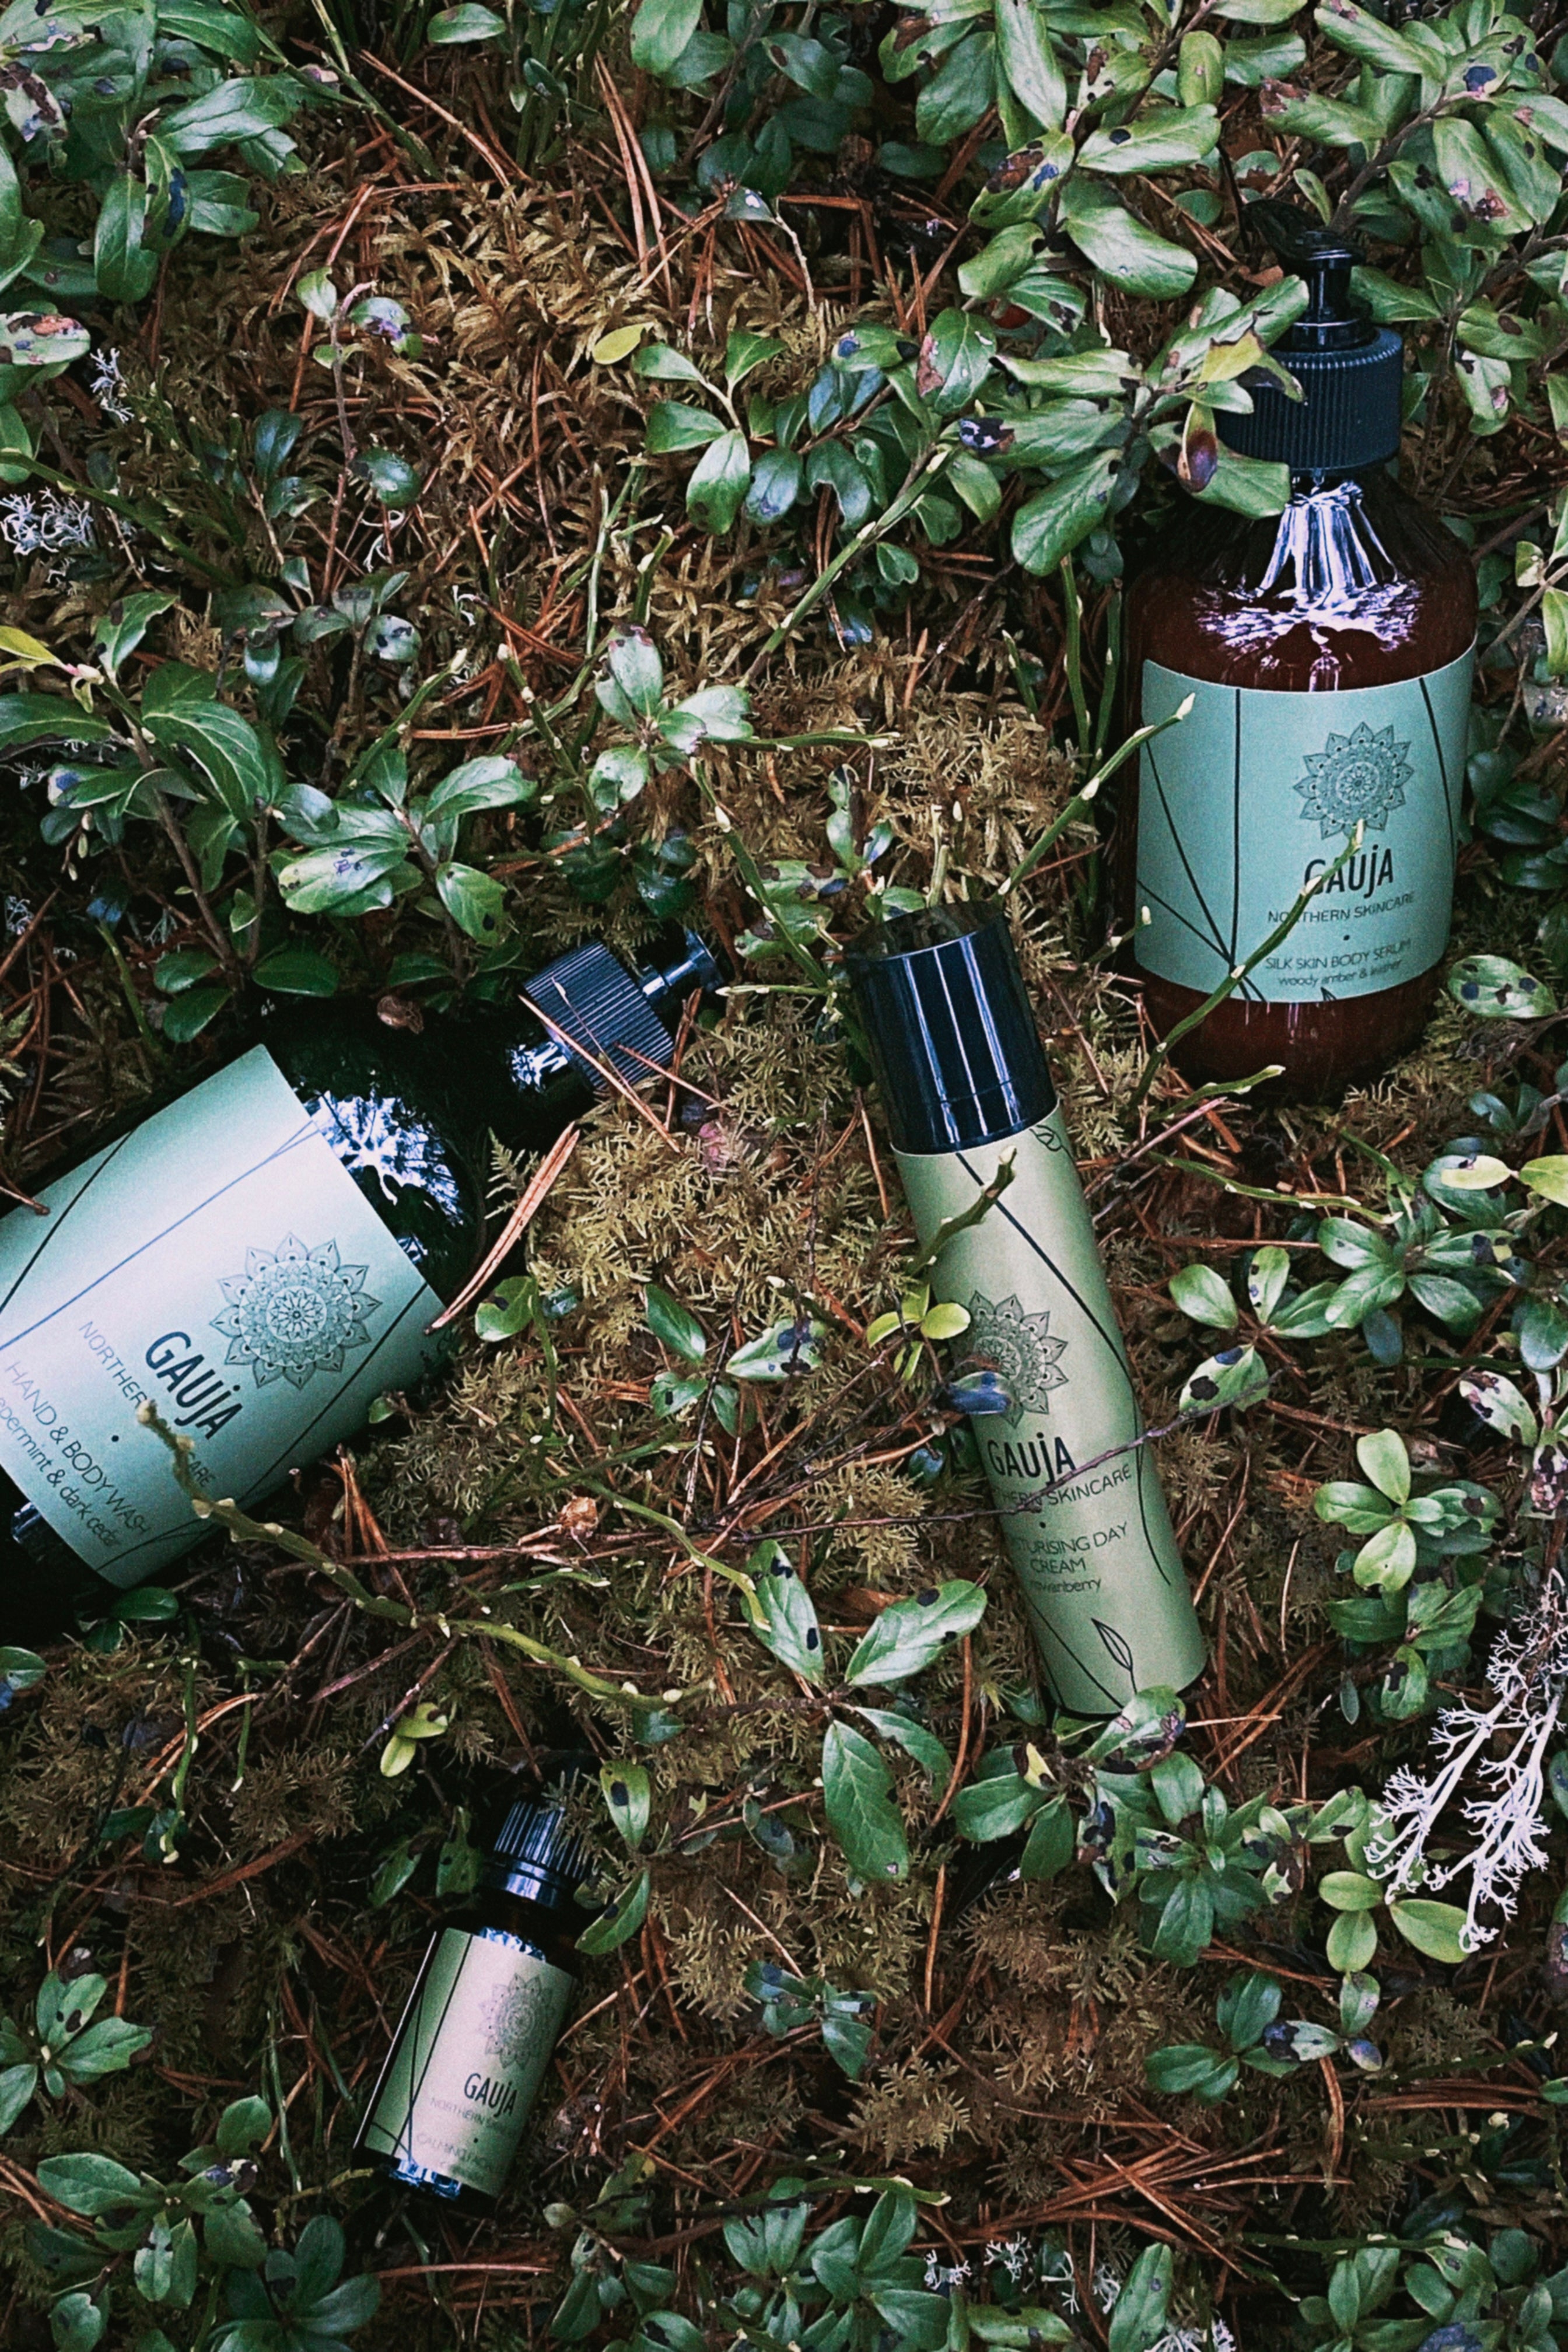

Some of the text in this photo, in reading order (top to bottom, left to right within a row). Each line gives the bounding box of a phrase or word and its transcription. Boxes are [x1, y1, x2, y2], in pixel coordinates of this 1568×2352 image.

[1267, 891, 1415, 923] NOTHERN SKINCARE
[1265, 938, 1412, 970] SILK SKIN BODY SERUM
[1278, 974, 1318, 987] woody
[1321, 970, 1357, 985] amber
[1359, 967, 1368, 979] &
[79, 1320, 148, 1409] NORTHER
[5, 1360, 152, 1534] HAND & BODY WASH
[46, 1468, 66, 1488] &
[60, 1485, 94, 1521] dark
[1046, 1464, 1132, 1506] SKINCARE
[1093, 1521, 1128, 1548] DAY
[1030, 1557, 1087, 1574] CREAM
